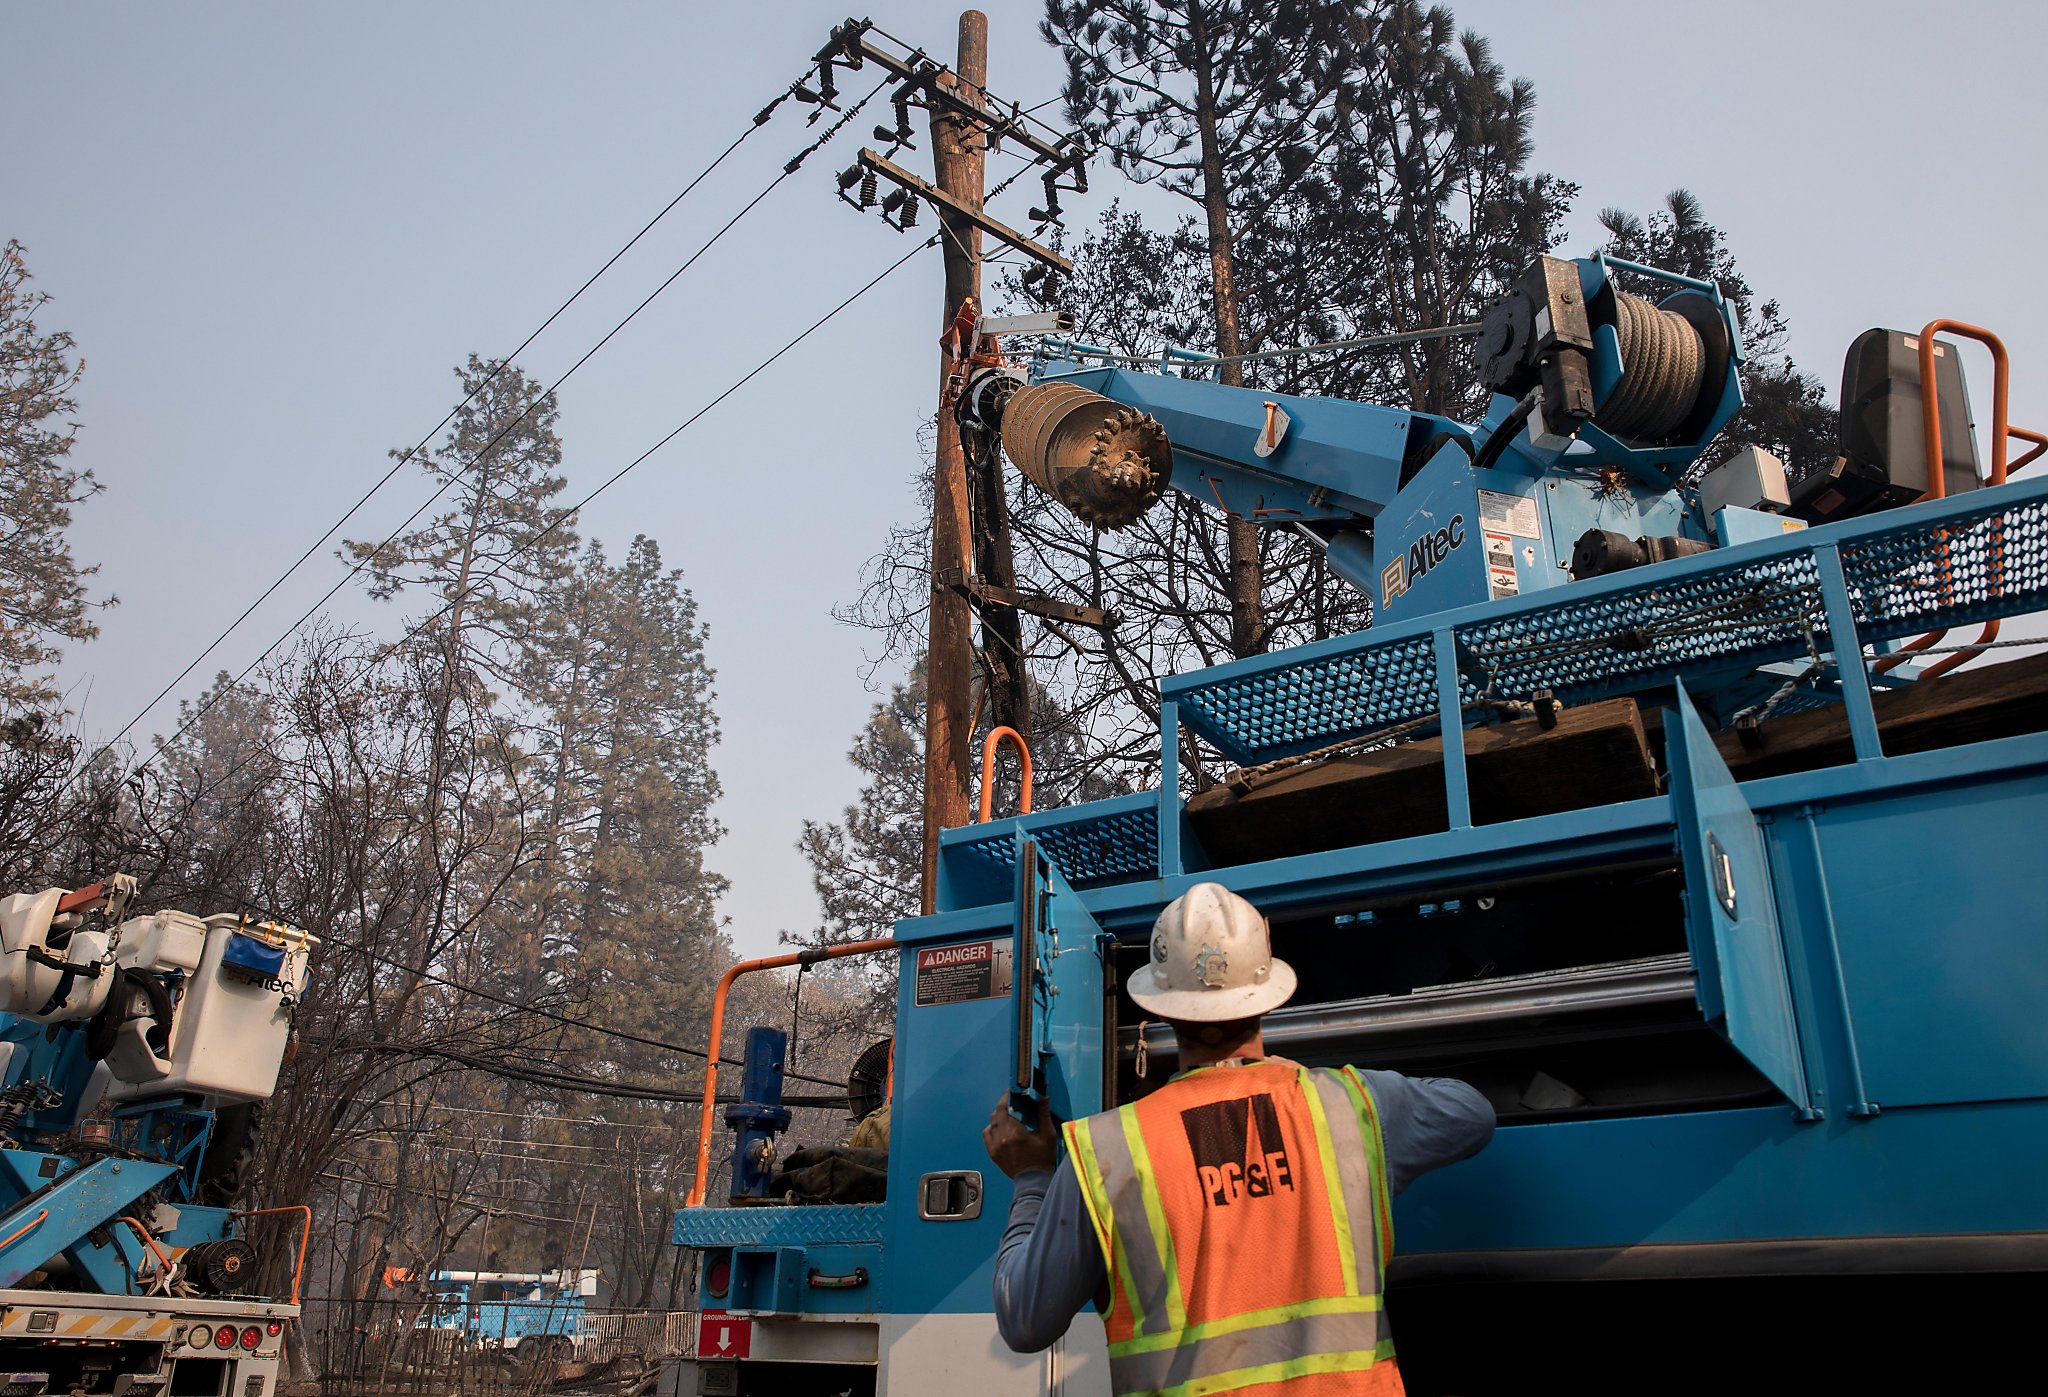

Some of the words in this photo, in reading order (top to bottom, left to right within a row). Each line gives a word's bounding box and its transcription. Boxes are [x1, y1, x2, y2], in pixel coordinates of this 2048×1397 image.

[1407, 514, 1465, 589] Altec
[936, 946, 987, 965] DANGER
[1199, 1151, 1293, 1207] PG&E
